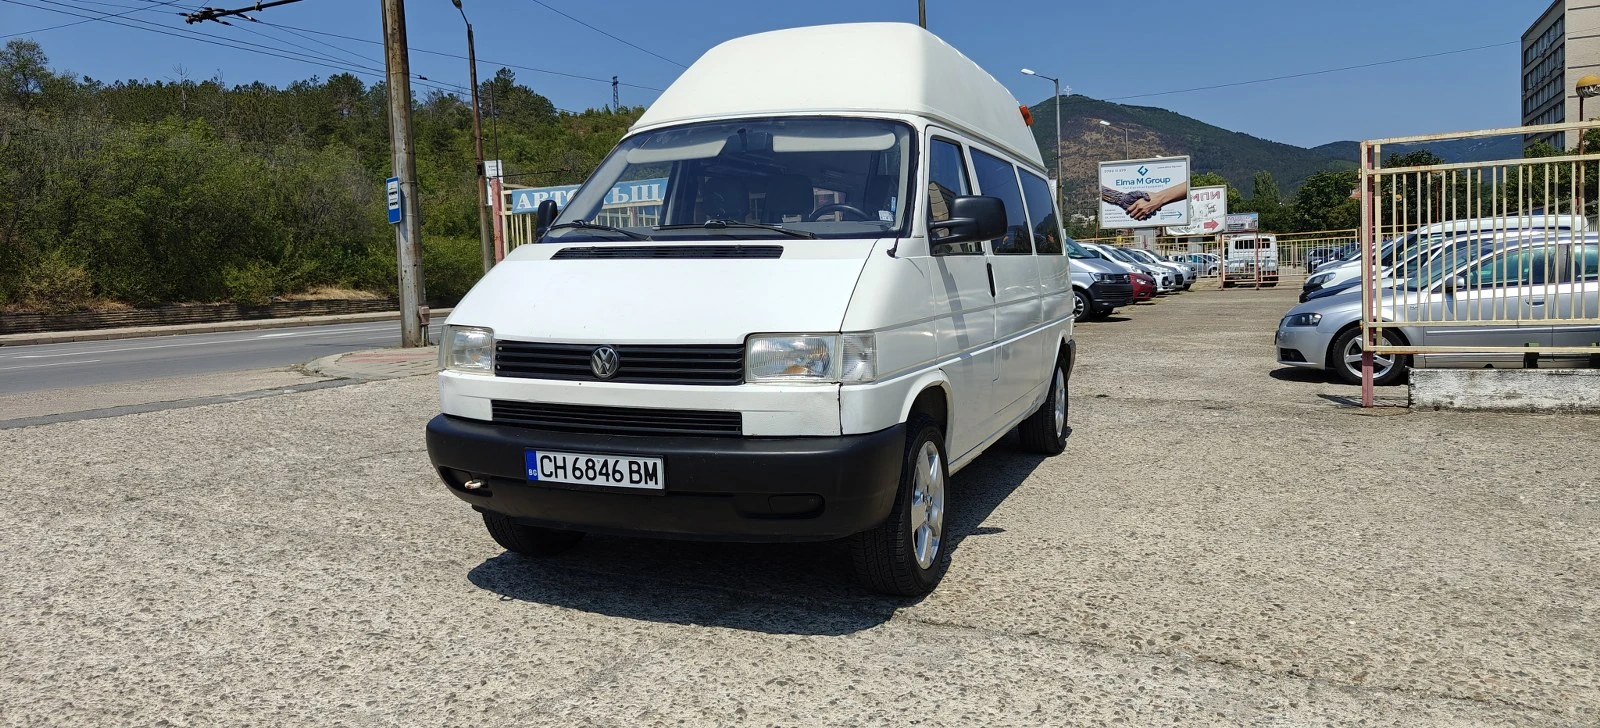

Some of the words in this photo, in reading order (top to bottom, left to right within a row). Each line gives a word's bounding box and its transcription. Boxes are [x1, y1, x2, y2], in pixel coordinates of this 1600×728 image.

[1145, 177, 1171, 185] Group
[528, 468, 538, 476] BG
[572, 457, 624, 482] 6846
[628, 460, 658, 485] BM
